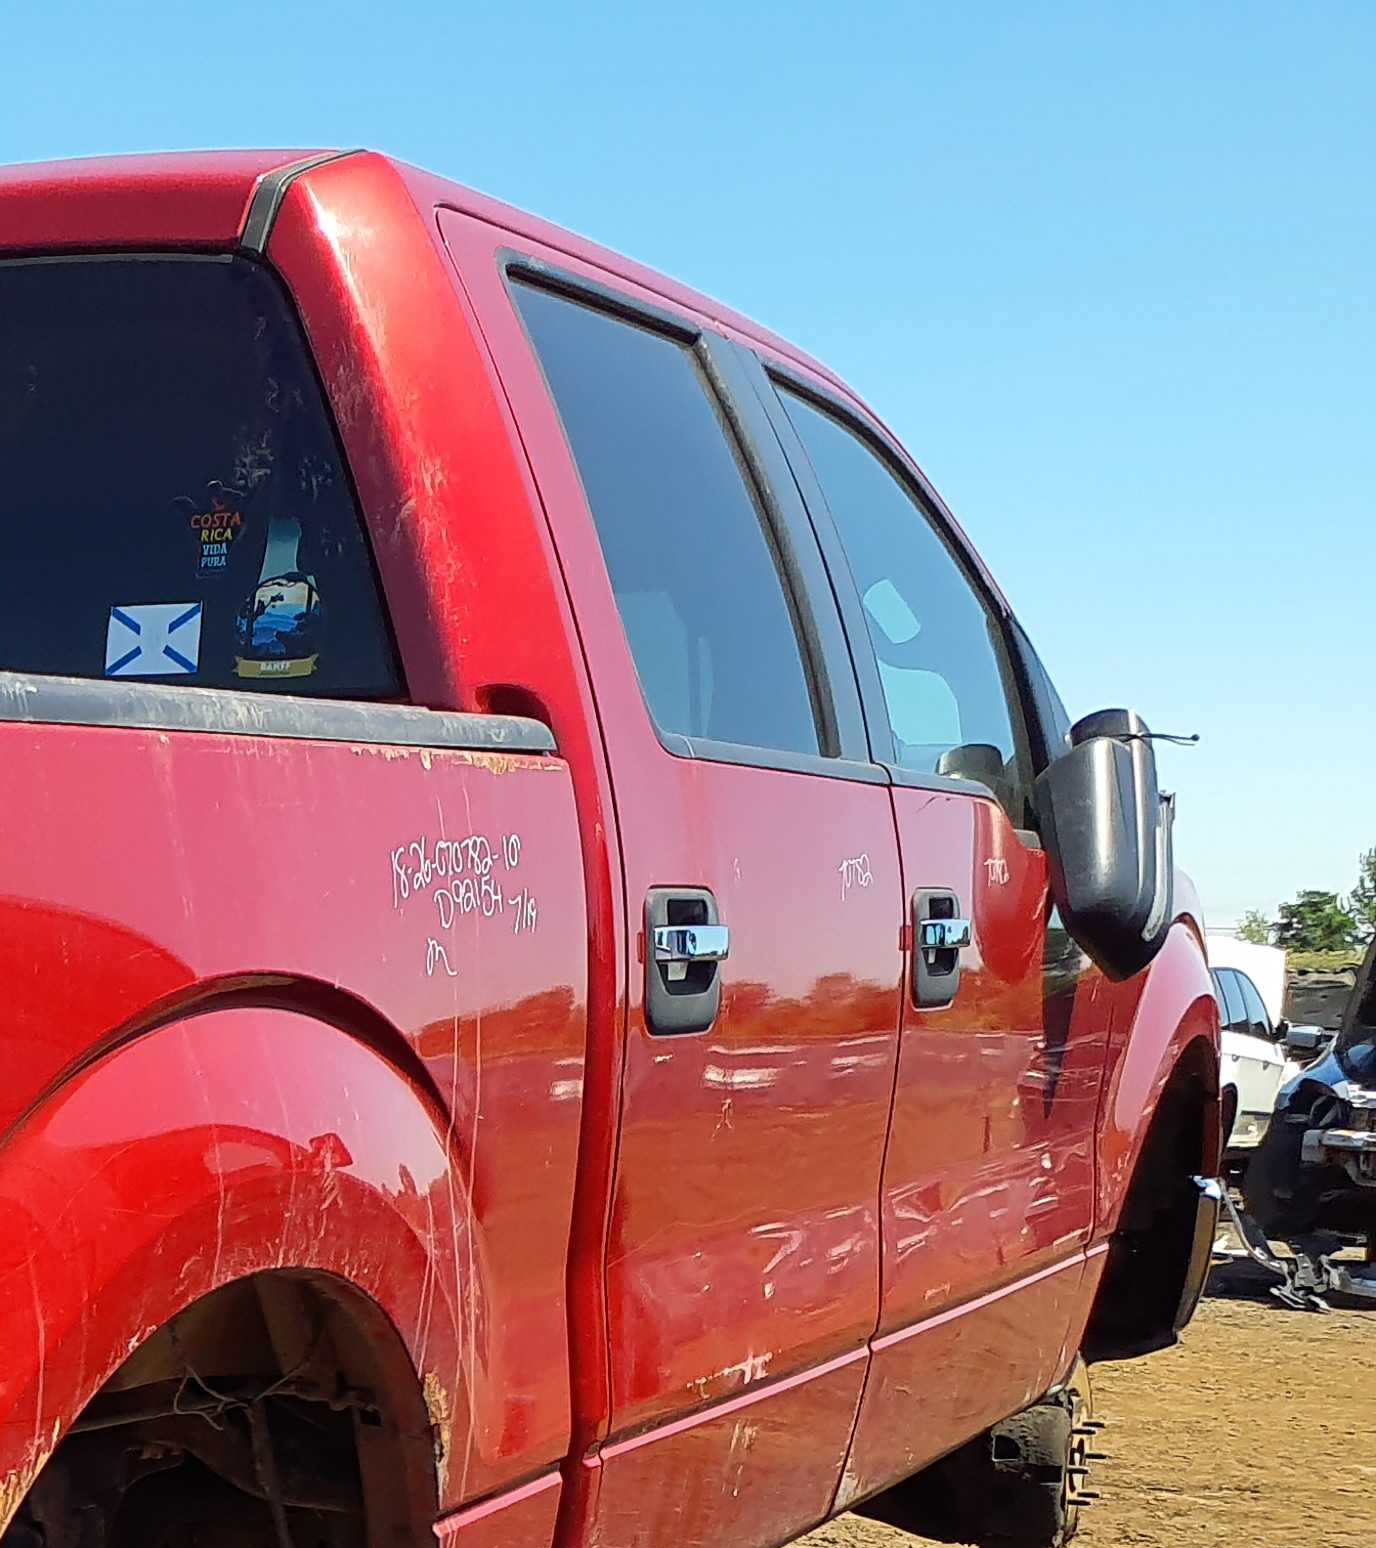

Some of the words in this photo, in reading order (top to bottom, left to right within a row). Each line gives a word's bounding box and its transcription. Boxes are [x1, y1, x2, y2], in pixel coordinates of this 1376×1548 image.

[191, 511, 241, 529] COSTA
[201, 527, 233, 543] RICA
[202, 542, 228, 556] VIDA
[201, 555, 227, 568] PURA
